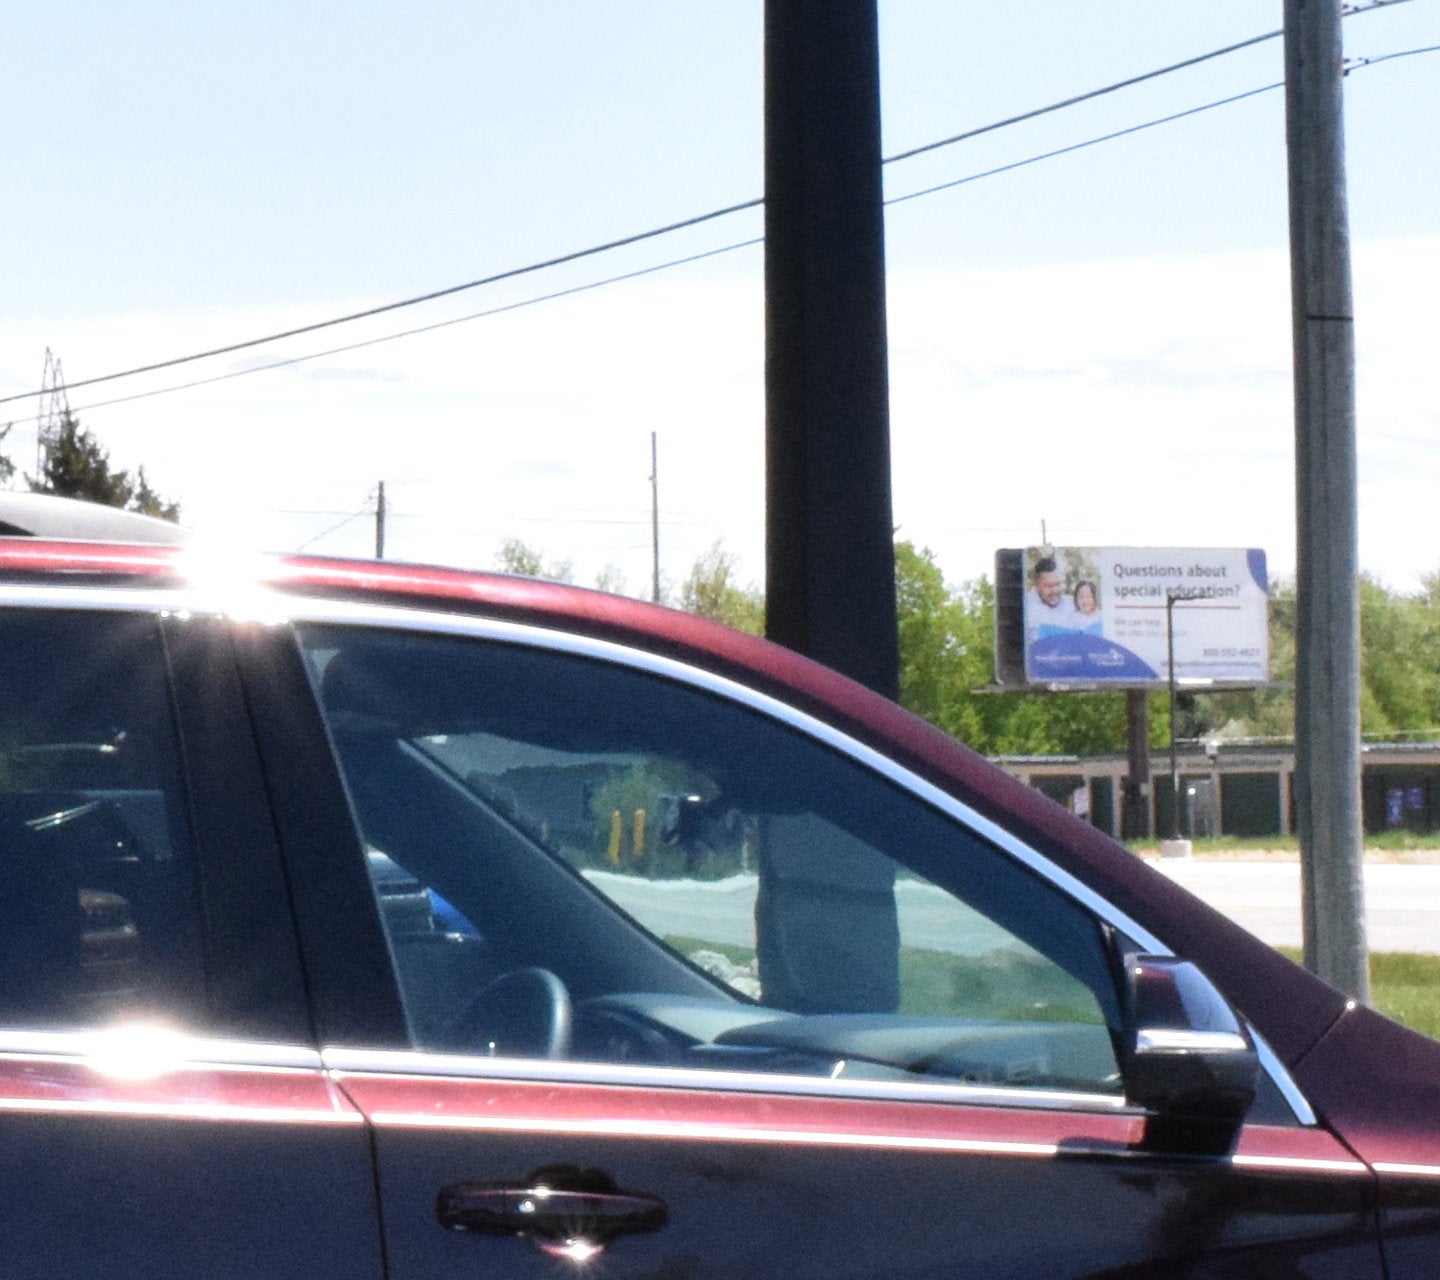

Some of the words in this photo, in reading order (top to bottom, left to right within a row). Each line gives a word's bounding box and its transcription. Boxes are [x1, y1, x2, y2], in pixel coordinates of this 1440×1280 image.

[1113, 563, 1182, 578] Questions
[1186, 563, 1227, 577] about
[1114, 584, 1161, 599] special
[1166, 584, 1241, 598] education?
